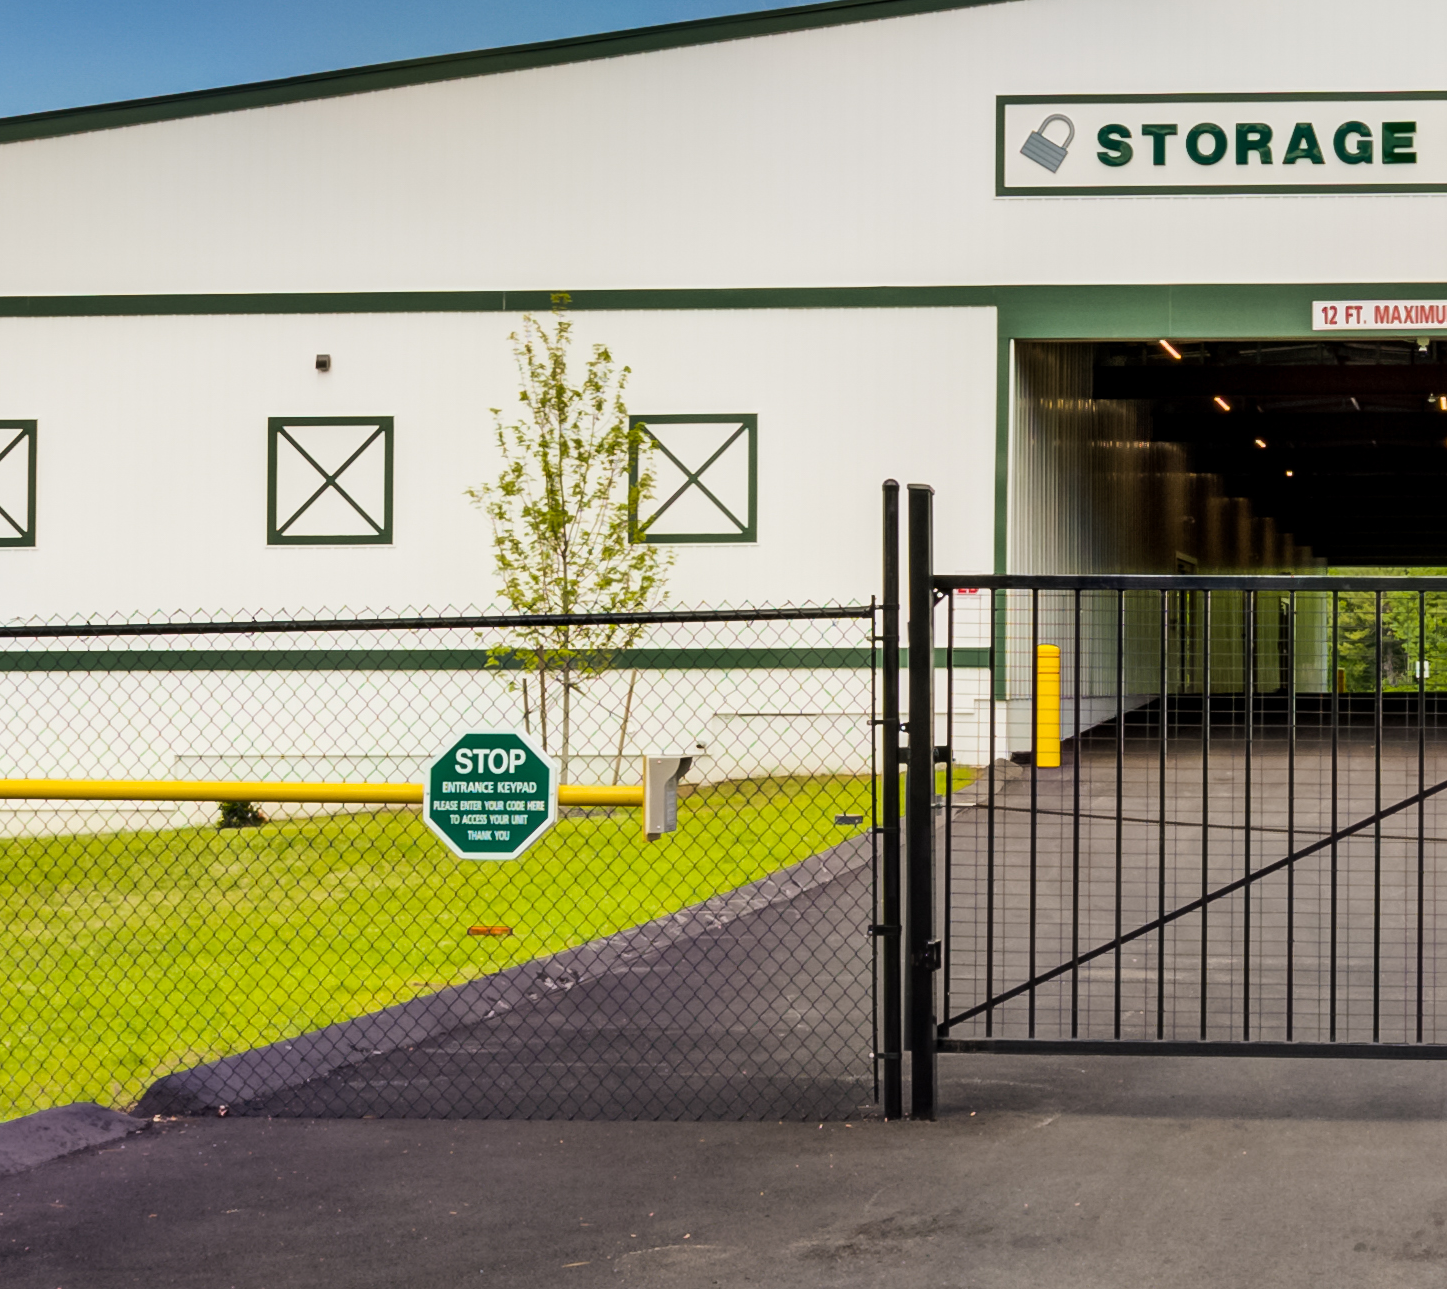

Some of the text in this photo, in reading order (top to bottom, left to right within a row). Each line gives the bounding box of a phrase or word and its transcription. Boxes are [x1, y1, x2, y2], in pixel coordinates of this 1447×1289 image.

[1096, 121, 1418, 168] STORAGE
[1321, 306, 1338, 325] 12
[1344, 305, 1367, 325] FT.
[455, 748, 527, 775] STOP
[442, 781, 537, 794] ENTRANCE KEYPAD
[433, 800, 545, 811] PLEASE ENTER YOUR CODE HERE
[450, 814, 528, 825] TO ACCESS YOUR UNIT
[467, 830, 510, 841] THANK YOU
